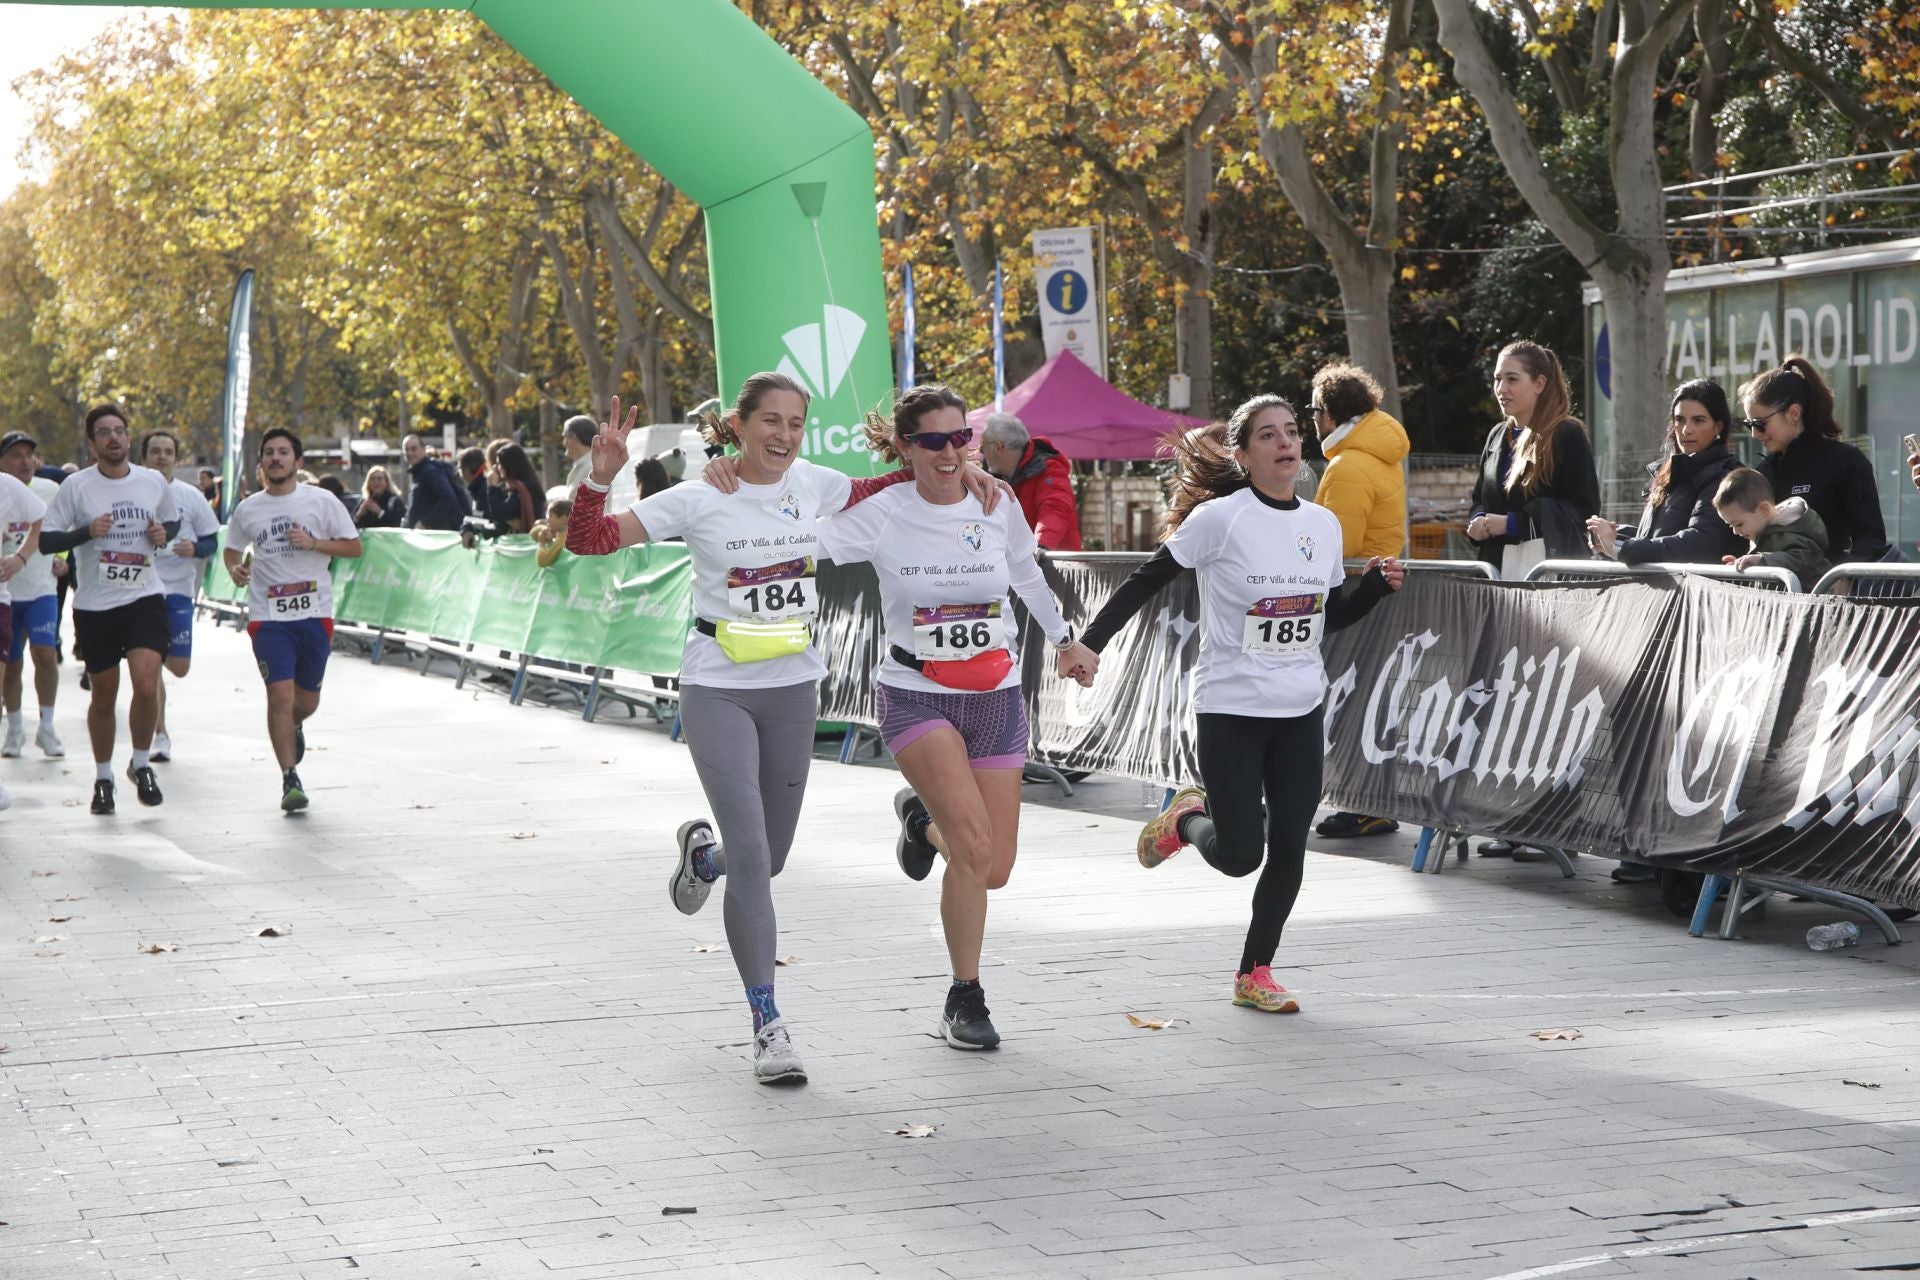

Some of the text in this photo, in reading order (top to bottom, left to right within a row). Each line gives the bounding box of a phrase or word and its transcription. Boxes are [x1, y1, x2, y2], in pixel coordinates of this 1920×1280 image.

[726, 540, 748, 550] CEIP
[751, 537, 770, 548] Villa
[774, 535, 786, 546] del
[764, 551, 798, 559] OLMEDO
[106, 565, 142, 582] 547
[900, 566, 921, 576] CEIP
[924, 565, 942, 575] Villa
[946, 564, 958, 575] del
[1246, 575, 1267, 585] CEIP
[1270, 574, 1285, 584] Villa
[1288, 575, 1297, 584] del
[276, 595, 311, 613] 548
[744, 581, 806, 613] 184
[929, 621, 991, 649] 186
[1258, 617, 1311, 645] 185
